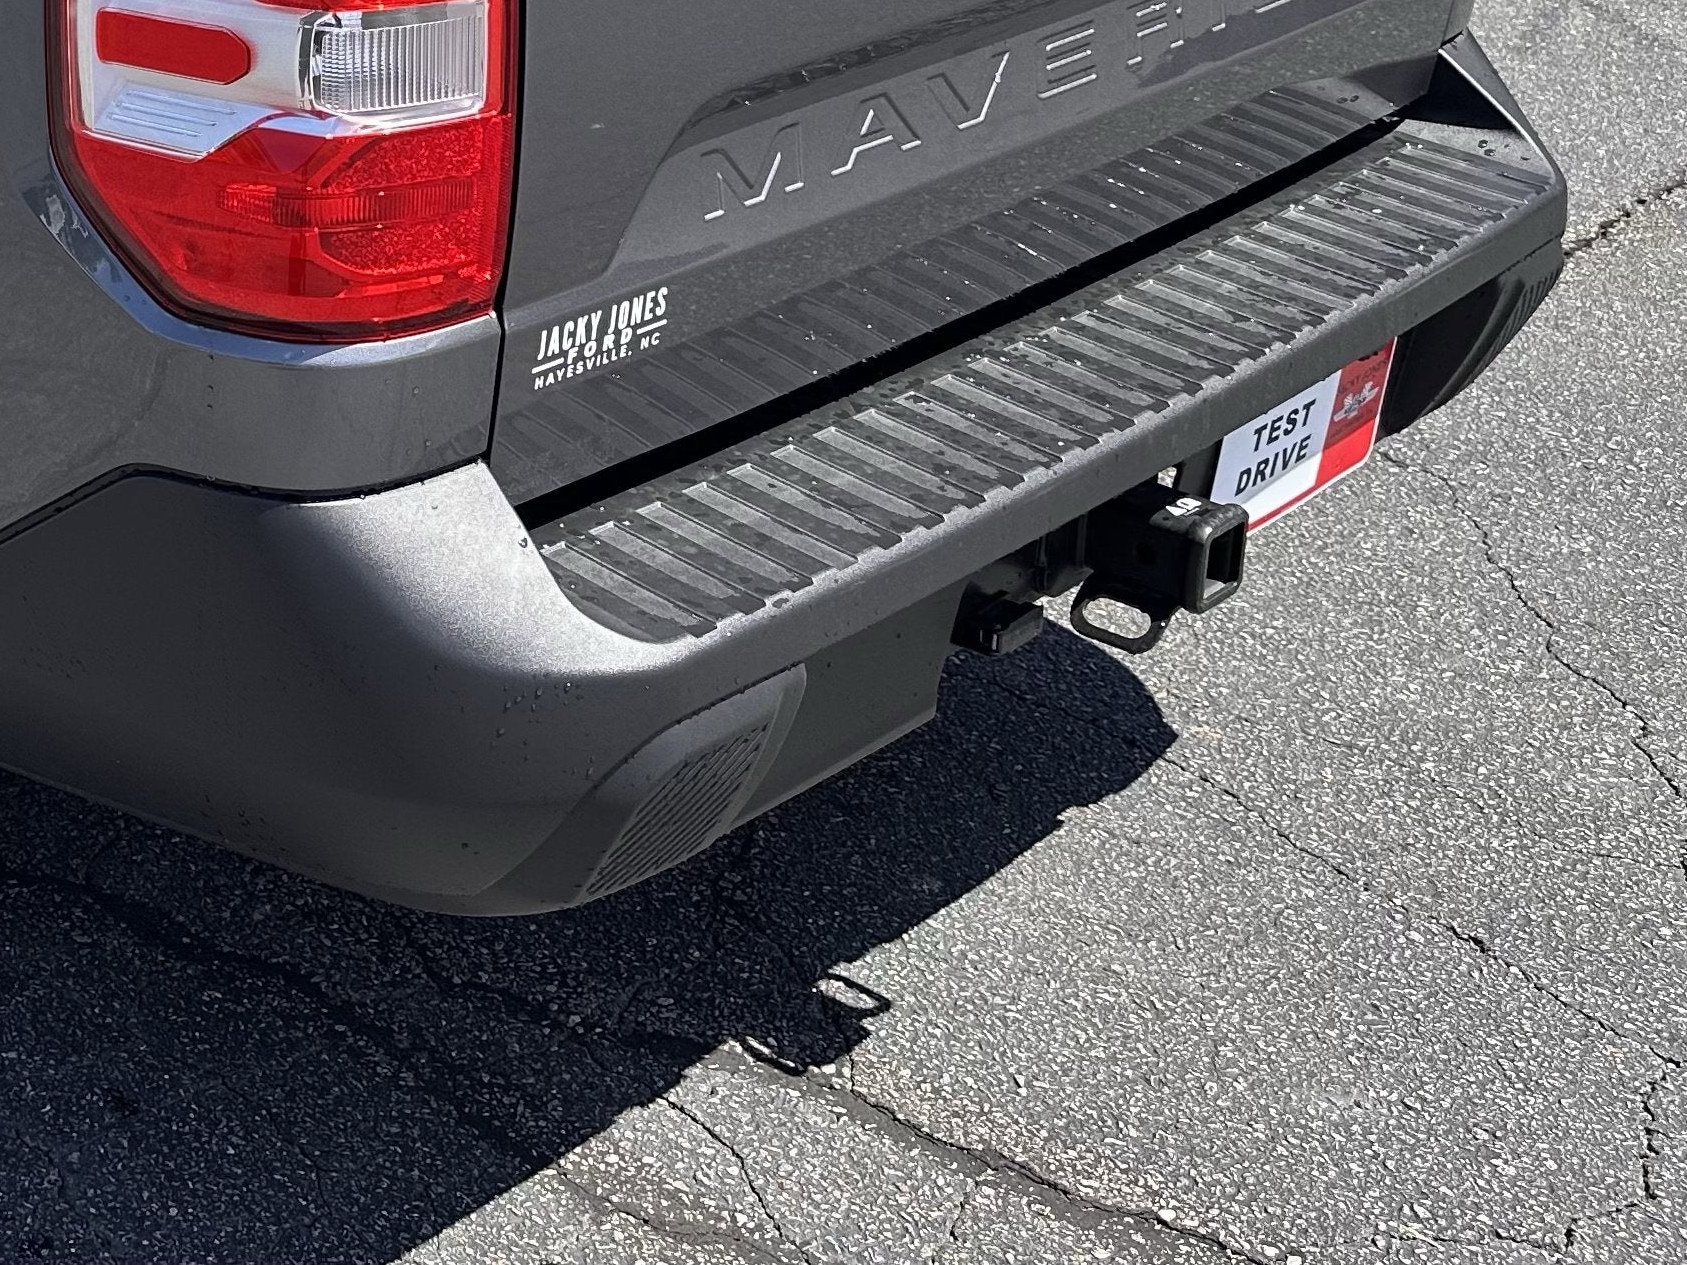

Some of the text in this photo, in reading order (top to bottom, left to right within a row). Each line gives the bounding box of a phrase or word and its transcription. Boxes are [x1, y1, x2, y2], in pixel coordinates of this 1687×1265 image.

[537, 286, 668, 361] JACKY JONES
[566, 327, 633, 365] FORD
[640, 332, 661, 351] NC
[1253, 398, 1317, 443] TEST
[1234, 433, 1312, 498] DRIVE
